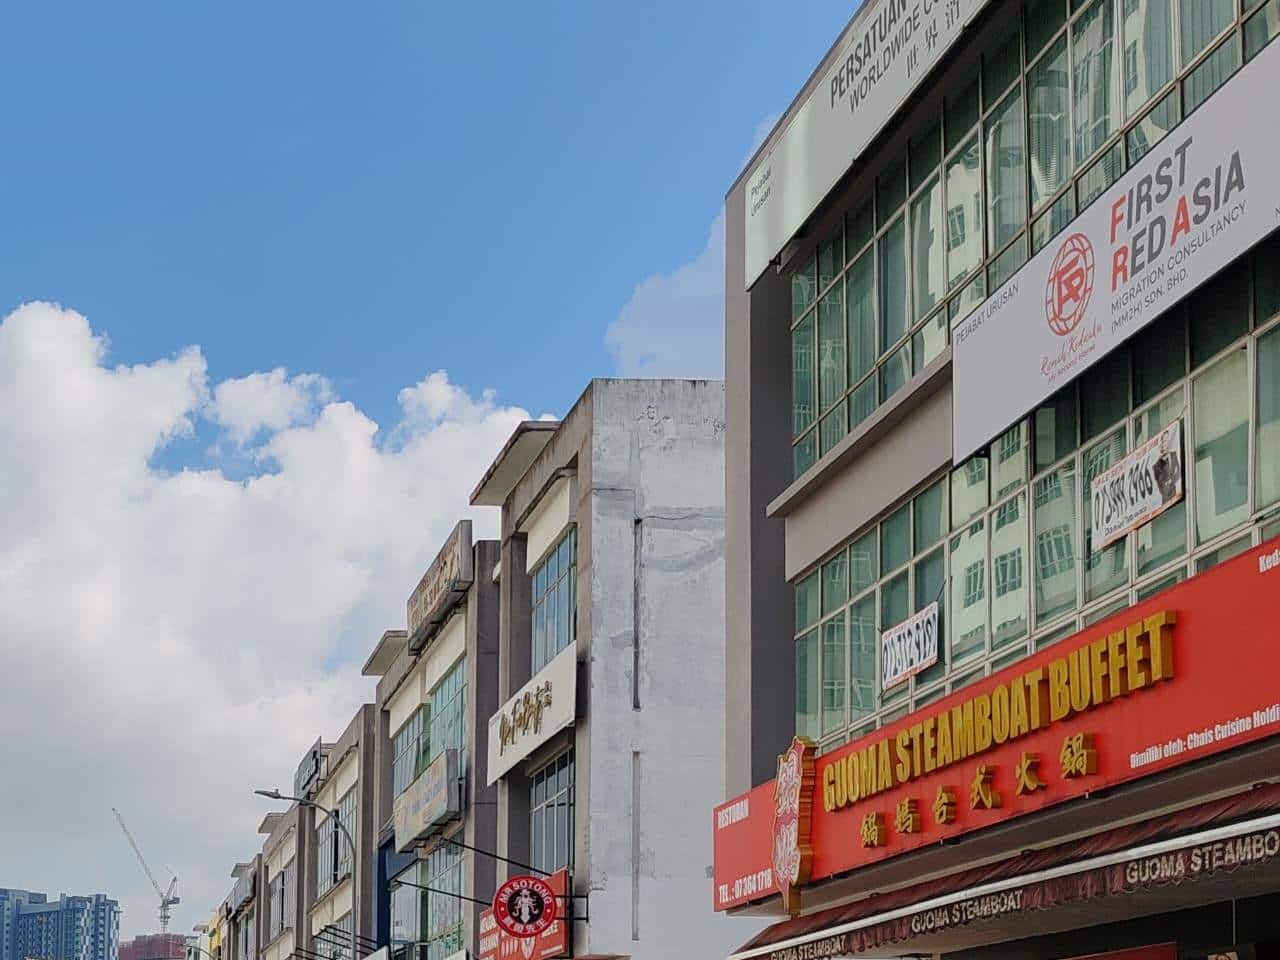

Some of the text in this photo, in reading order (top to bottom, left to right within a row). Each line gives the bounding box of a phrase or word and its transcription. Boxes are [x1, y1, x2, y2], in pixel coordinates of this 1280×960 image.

[830, 0, 907, 109] PERSATUAN
[850, 3, 921, 112] WORLDWIDE
[1110, 136, 1193, 245] FIRST
[1111, 215, 1167, 293] RED
[1170, 149, 1245, 248] ASIA
[1111, 263, 1165, 316] MIGRATION
[1167, 200, 1247, 271] CONSULTANCY
[956, 310, 986, 346] PEJABAT
[986, 282, 1020, 318] URUSAN
[1144, 287, 1165, 309] SDN.
[1167, 268, 1189, 292] BHD.
[1258, 550, 1280, 573] Ked
[823, 610, 1171, 812] GUOMA STEAMBOAT BUFFET
[1214, 715, 1253, 741] Cuisine
[718, 798, 750, 830] RESTORAN
[1126, 831, 1280, 884] GUOMA STEAMBO
[512, 879, 553, 905] SOTONG
[911, 890, 1024, 933] GUOMA STEAMBOAT
